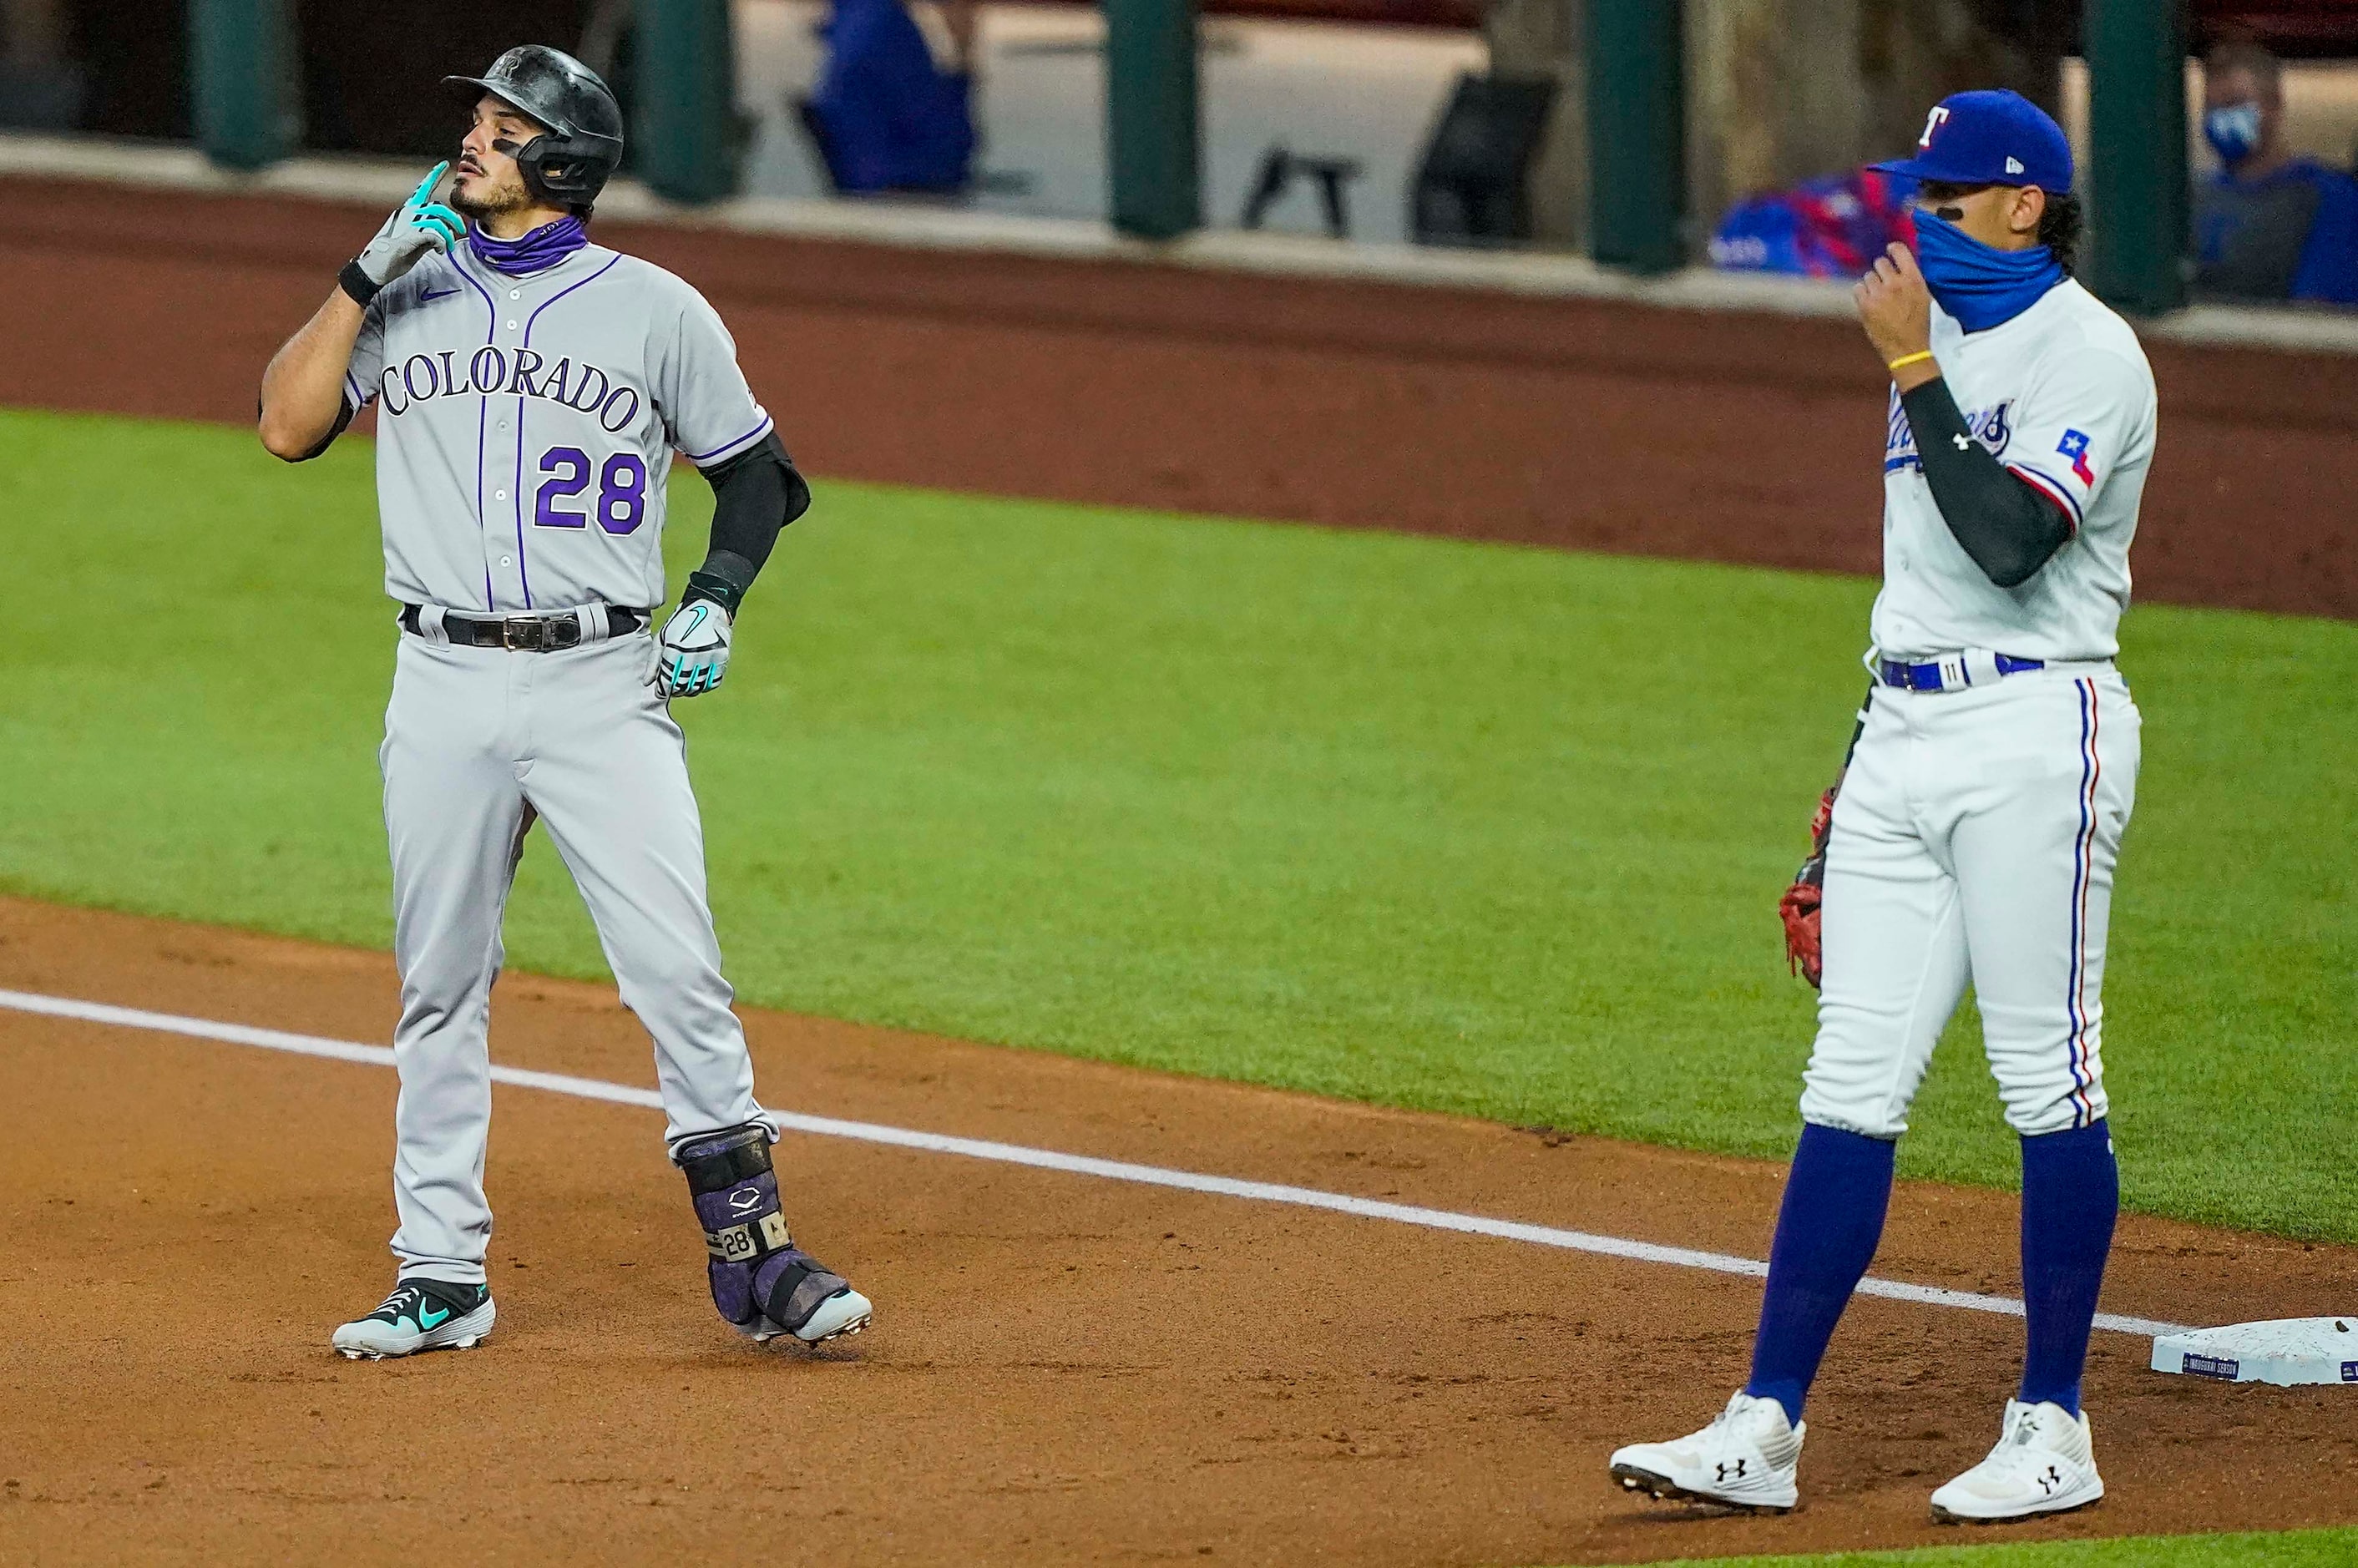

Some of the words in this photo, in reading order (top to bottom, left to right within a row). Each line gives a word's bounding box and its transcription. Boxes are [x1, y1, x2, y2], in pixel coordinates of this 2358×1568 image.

[1919, 106, 1950, 147] T
[378, 346, 639, 432] COLORADO
[532, 446, 647, 537] 28
[724, 1231, 750, 1256] 28
